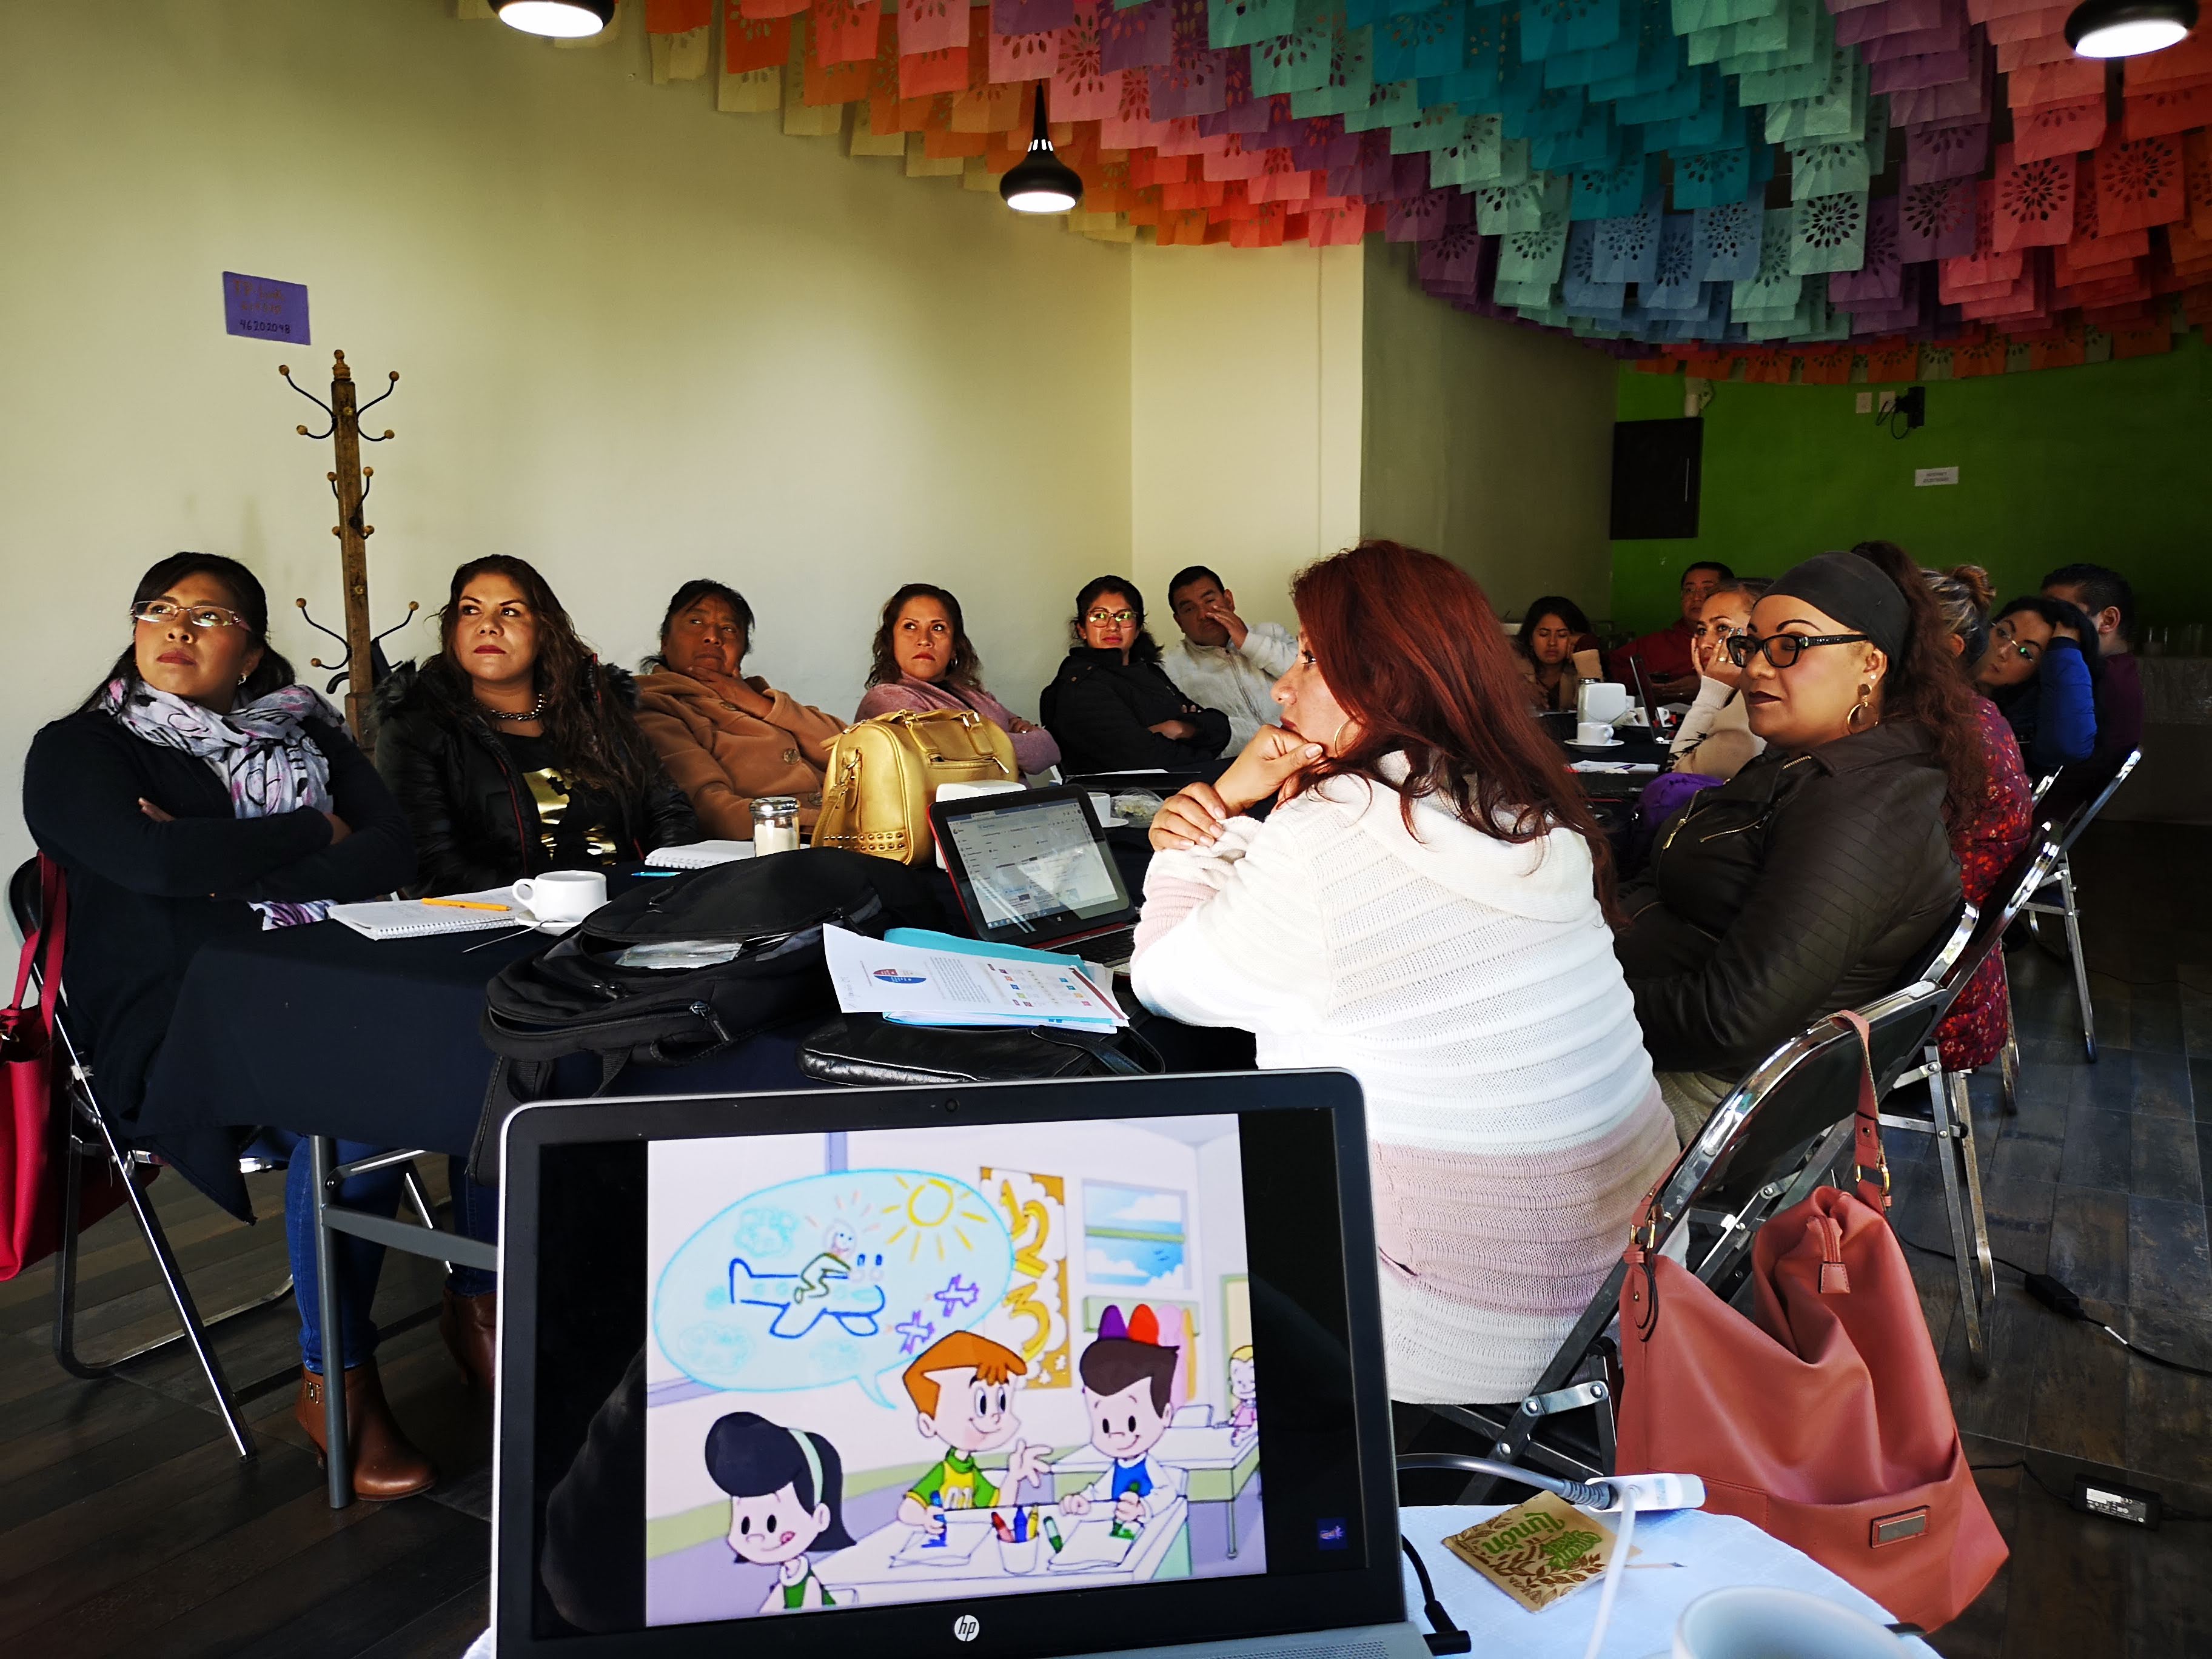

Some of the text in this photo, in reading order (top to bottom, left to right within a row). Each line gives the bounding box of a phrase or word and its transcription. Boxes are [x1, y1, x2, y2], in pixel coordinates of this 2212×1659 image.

[1014, 1199, 1050, 1279] 2
[1002, 1281, 1051, 1362] 3
[957, 1614, 977, 1641] hp
